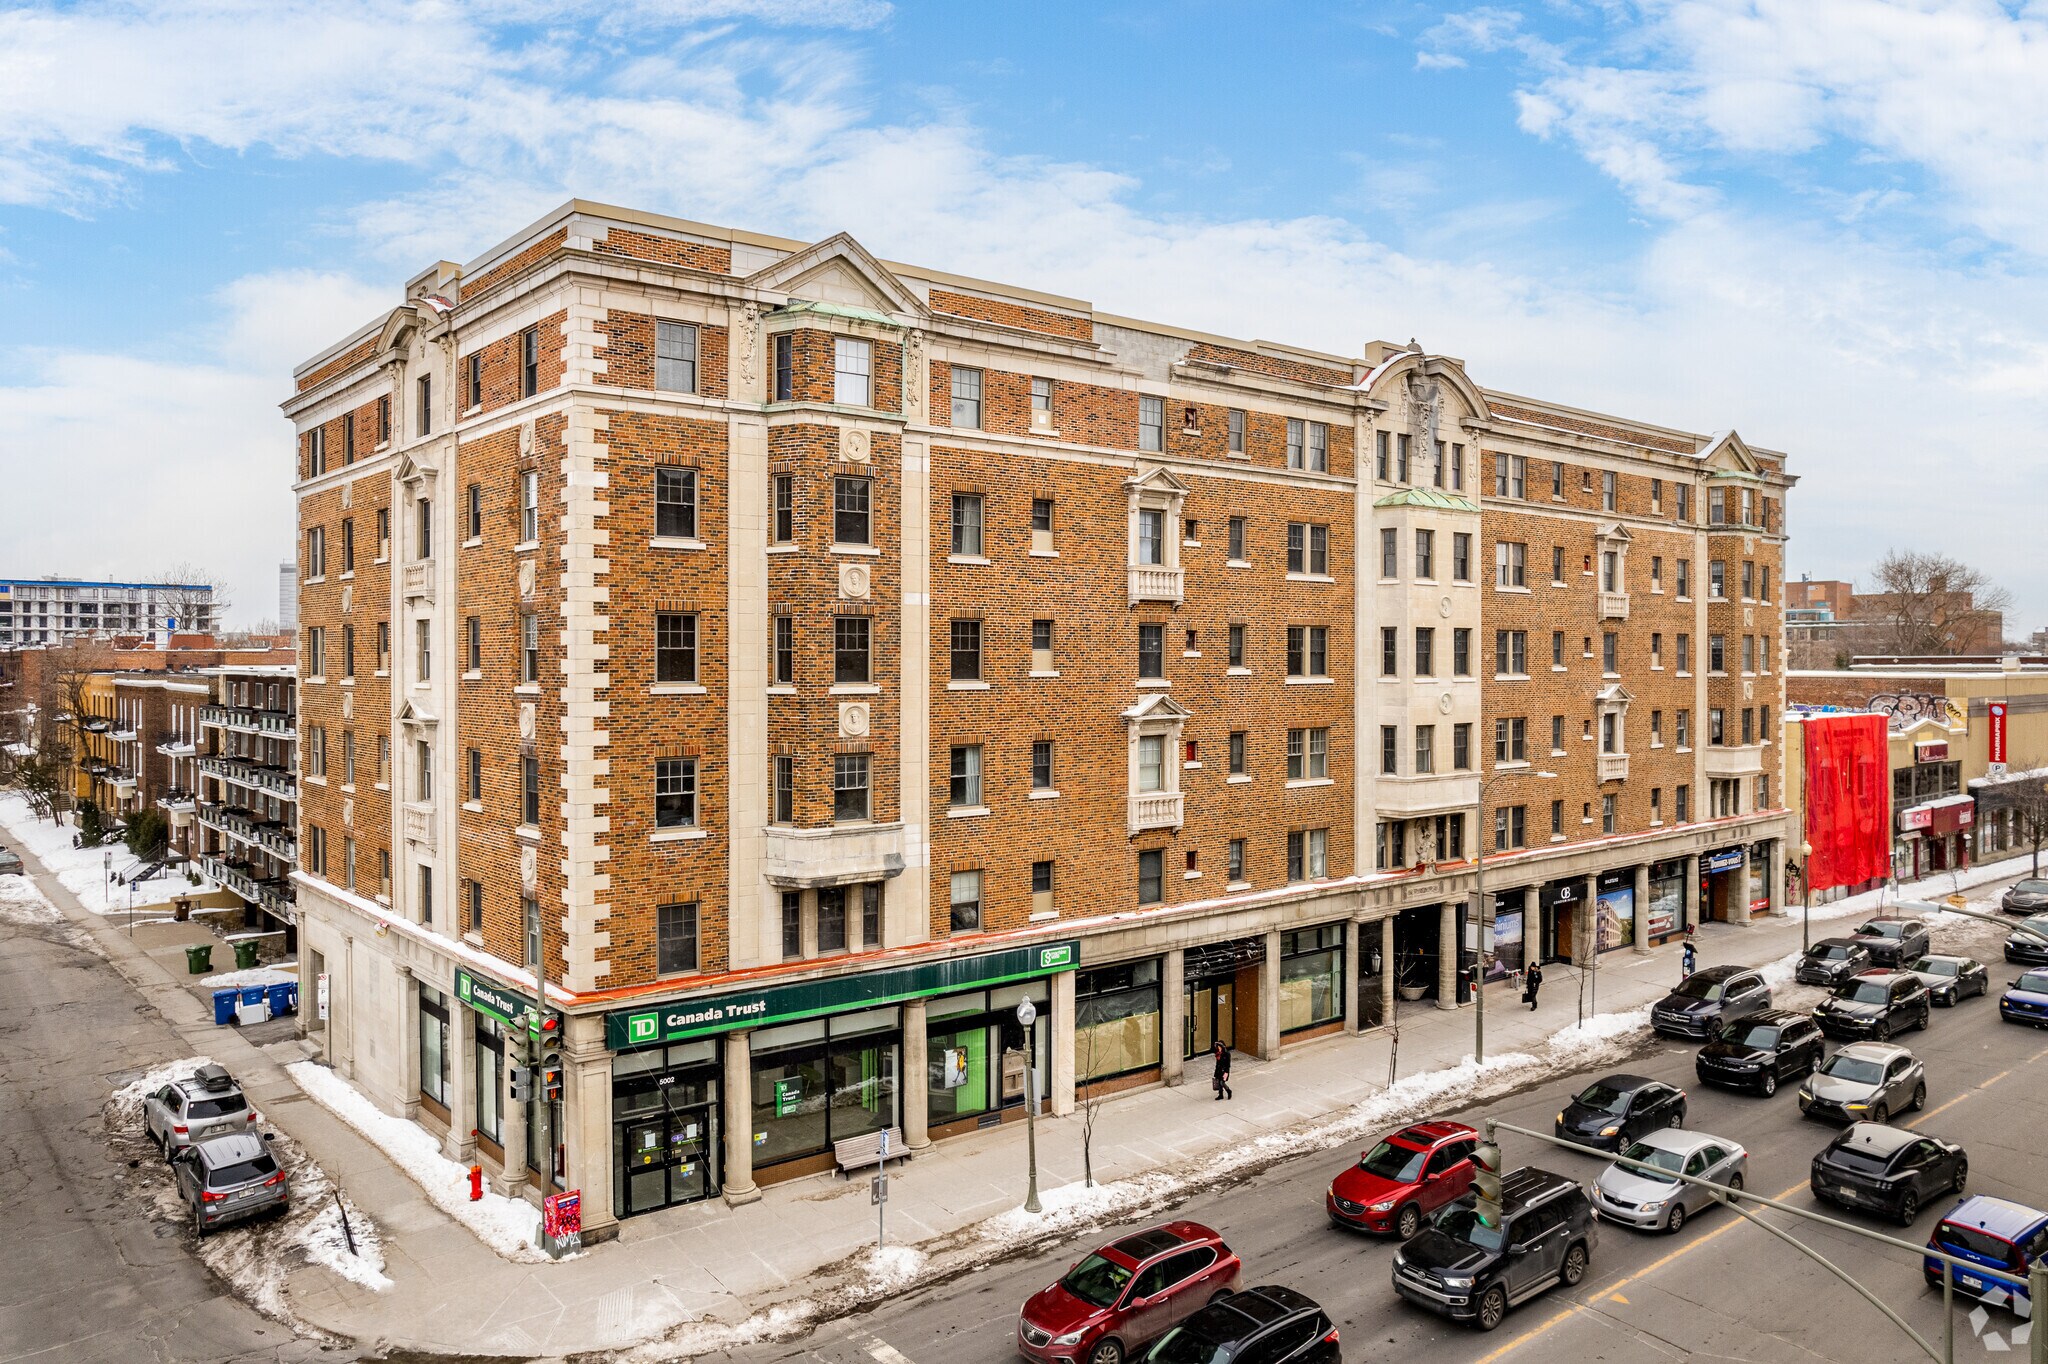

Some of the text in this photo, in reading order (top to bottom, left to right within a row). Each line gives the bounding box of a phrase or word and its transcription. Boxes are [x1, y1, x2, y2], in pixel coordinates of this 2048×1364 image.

[473, 984, 496, 1005] Canada
[496, 995, 514, 1014] Trust
[632, 1000, 766, 1037] TD Canada Trust
[659, 1076, 675, 1085] 5002
